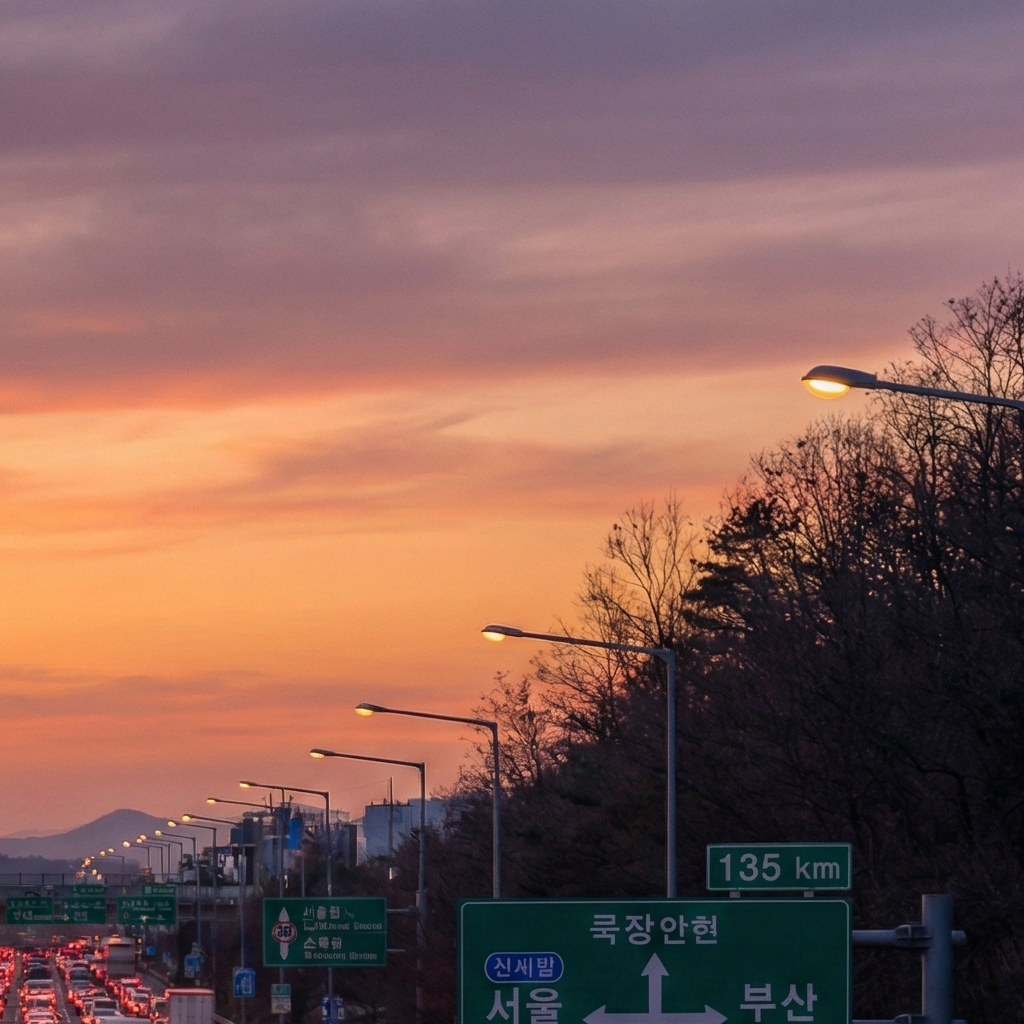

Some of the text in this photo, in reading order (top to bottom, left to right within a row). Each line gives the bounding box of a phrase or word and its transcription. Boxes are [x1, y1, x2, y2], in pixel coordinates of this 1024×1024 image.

[719, 853, 840, 882] 135 km
[739, 983, 818, 1023] 부산
